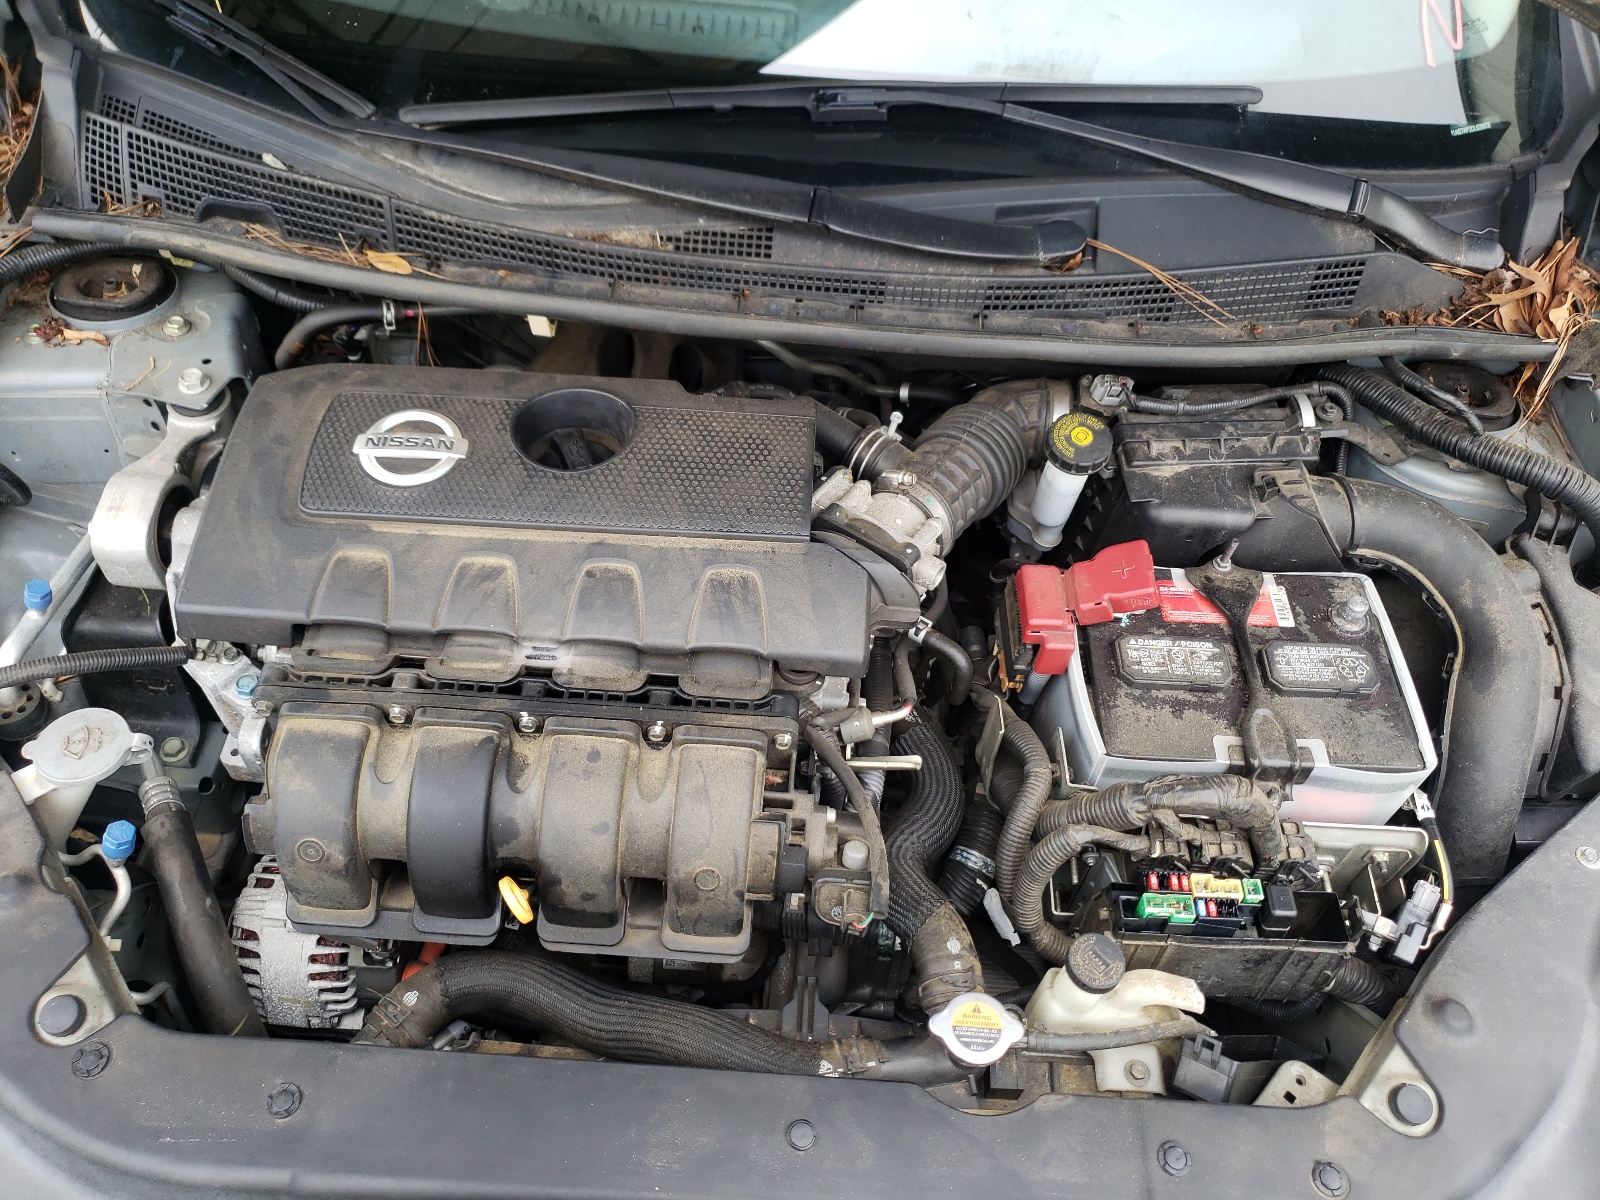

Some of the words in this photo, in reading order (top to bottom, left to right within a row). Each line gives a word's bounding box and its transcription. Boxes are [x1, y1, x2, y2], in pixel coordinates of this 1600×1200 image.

[365, 435, 456, 451] NISSAN
[1137, 638, 1172, 647] DANGER
[1181, 641, 1213, 649] POISON
[961, 1013, 992, 1021] WARNING
